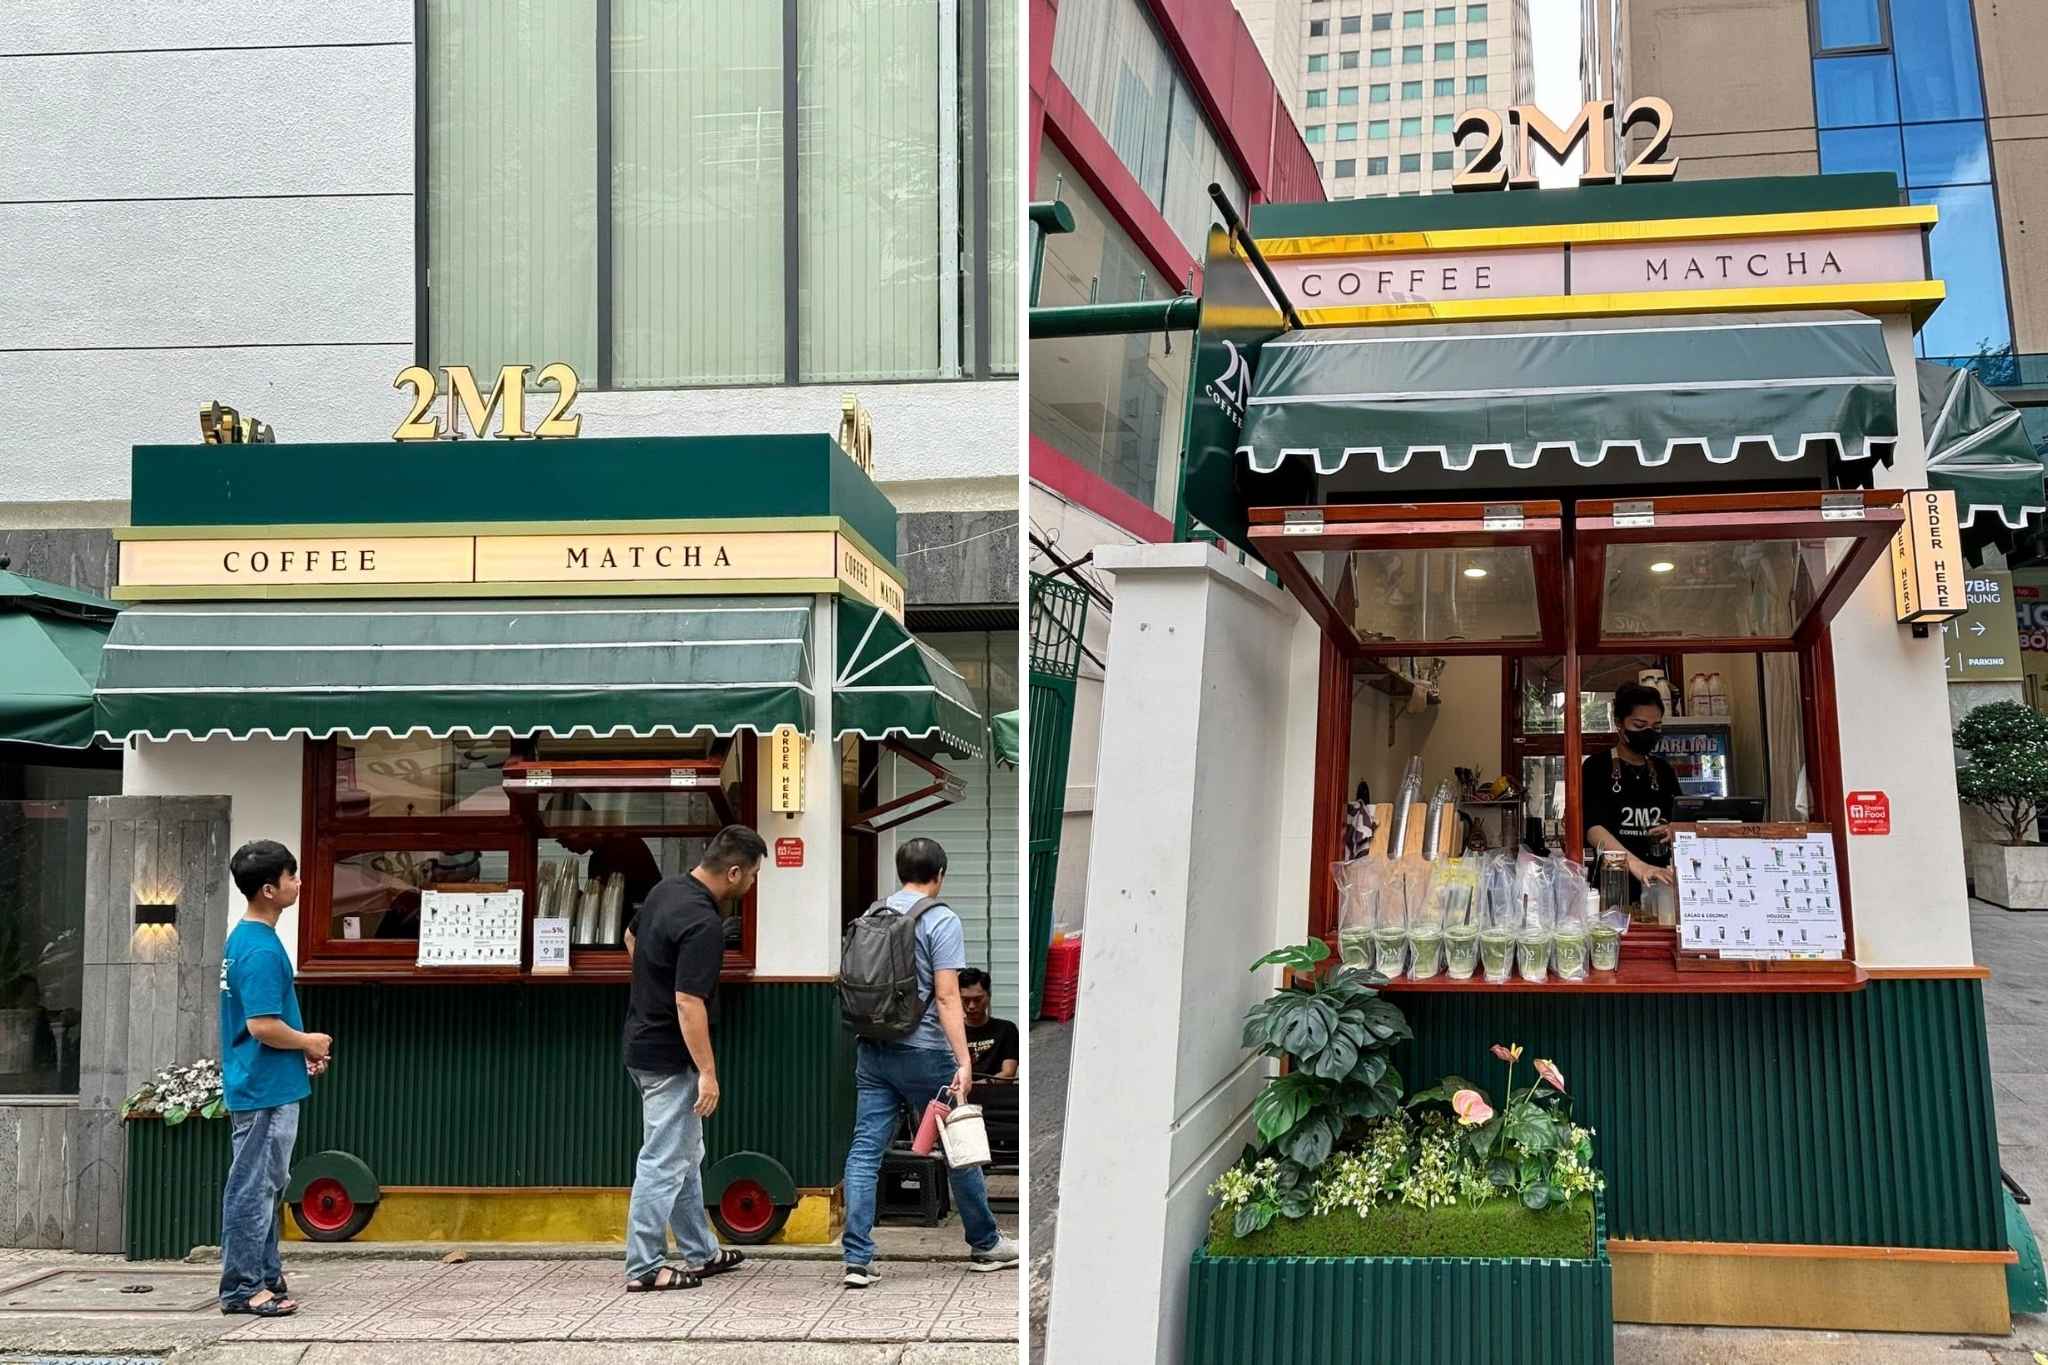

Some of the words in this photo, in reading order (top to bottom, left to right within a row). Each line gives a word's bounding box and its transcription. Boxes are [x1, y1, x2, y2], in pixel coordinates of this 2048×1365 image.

[1452, 97, 1680, 191] 2M2
[1302, 265, 1492, 297] COFFEE
[1646, 251, 1842, 281] MATCHA
[393, 362, 582, 440] 2M2
[1926, 493, 1943, 549] ORDER
[223, 550, 377, 573] COFFEE
[566, 546, 730, 569] MATCHA
[844, 551, 869, 588] COFFEE
[880, 580, 902, 613] MATCHA
[1901, 568, 1911, 614] HERE
[1934, 560, 1950, 607] HERE
[1969, 657, 2004, 666] PARKING
[782, 729, 790, 770] ORDER
[1621, 806, 1661, 827] 2M2
